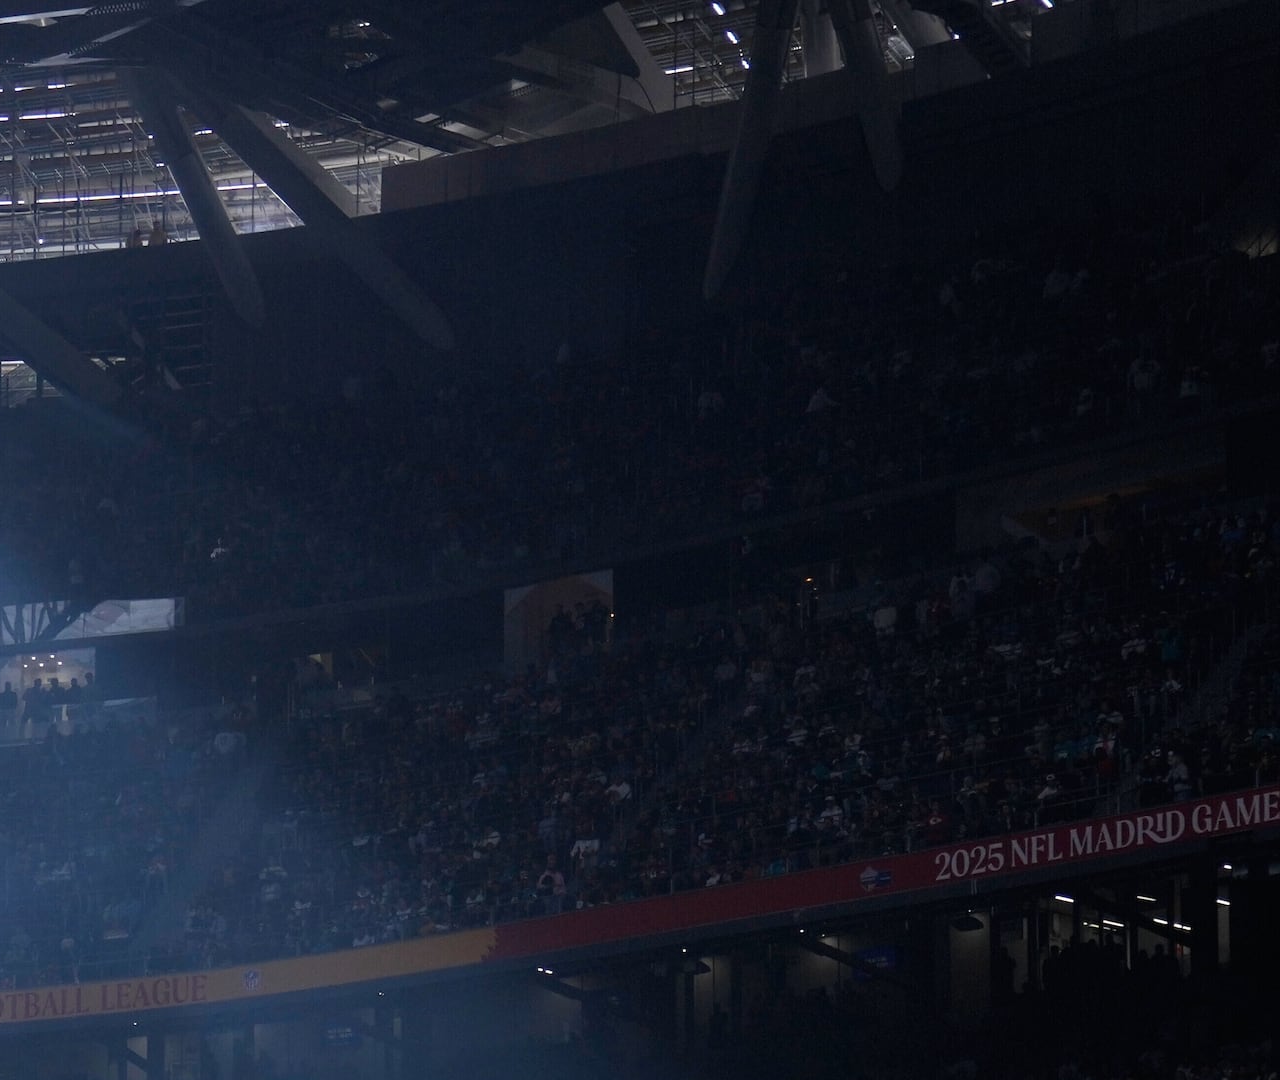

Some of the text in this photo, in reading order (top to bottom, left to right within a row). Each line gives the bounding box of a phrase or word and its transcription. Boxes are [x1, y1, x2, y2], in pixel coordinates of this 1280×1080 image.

[935, 790, 1280, 881] 2025 NFL MADRID GAME
[100, 974, 208, 1013] LEAGUE
